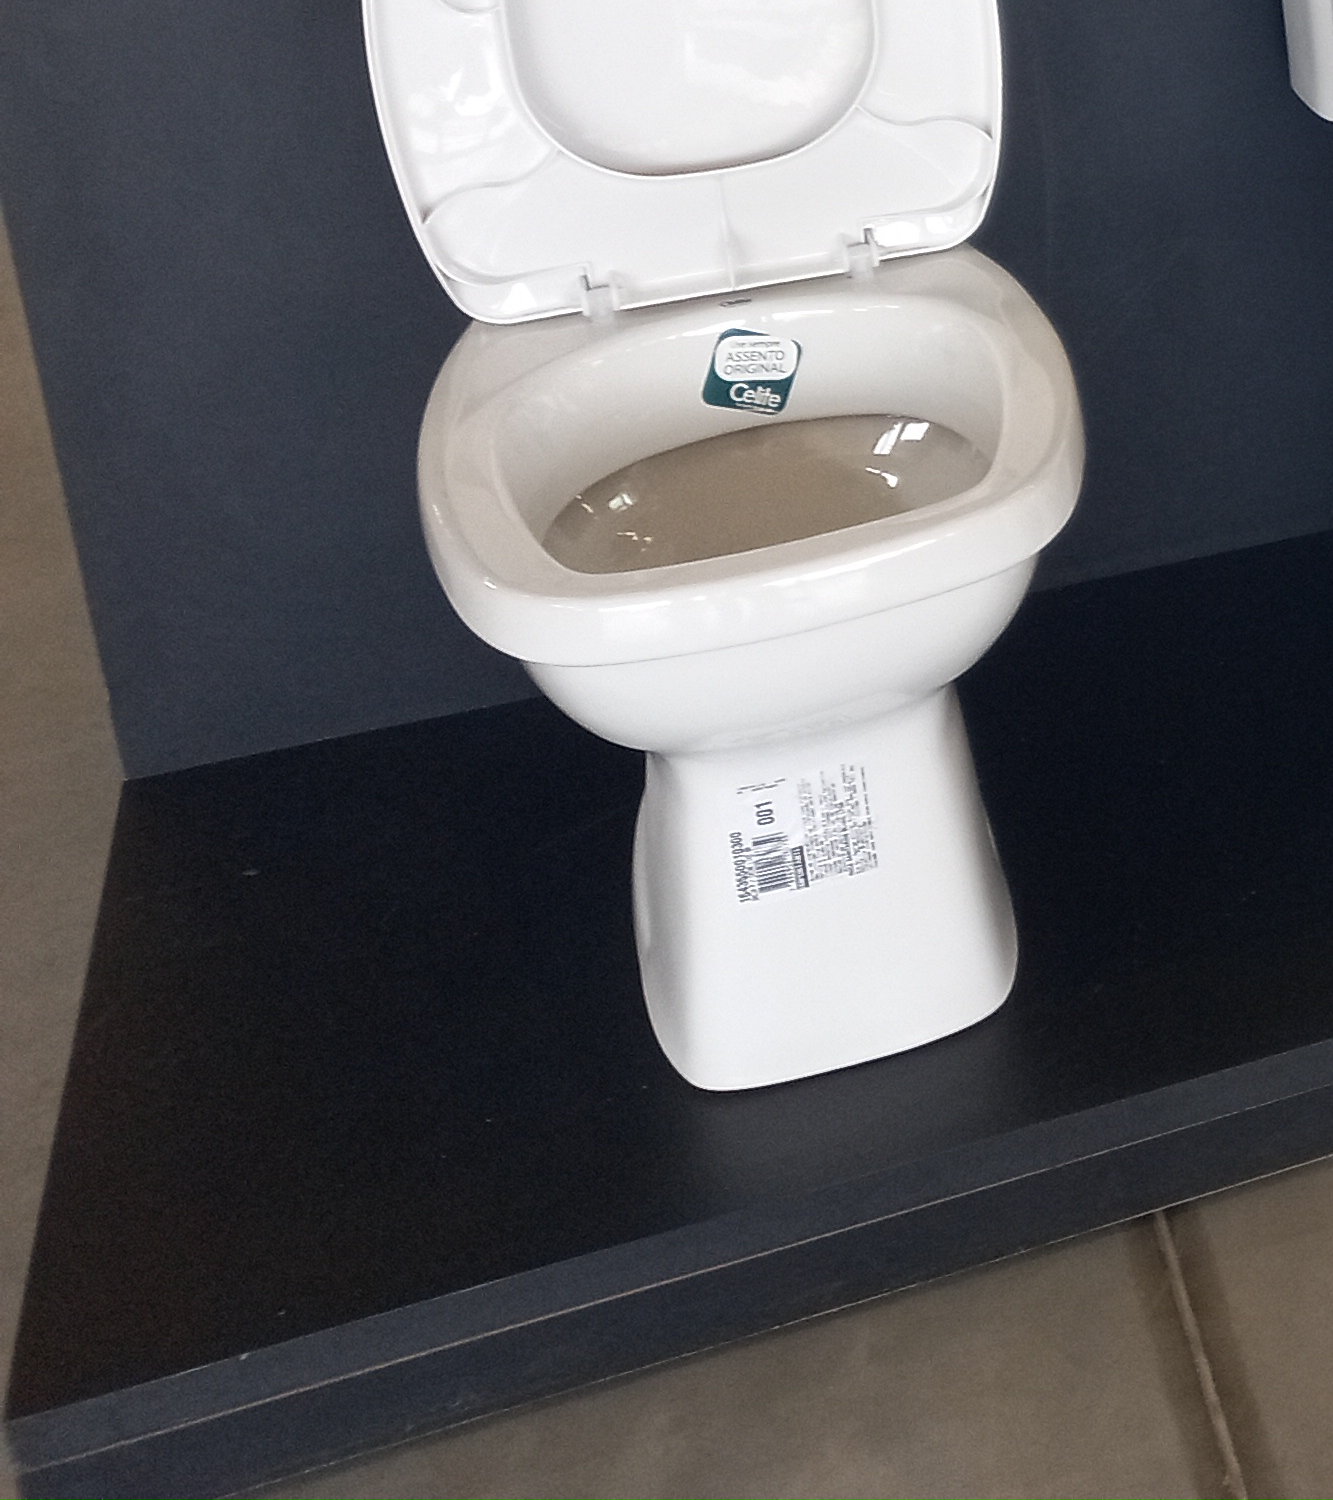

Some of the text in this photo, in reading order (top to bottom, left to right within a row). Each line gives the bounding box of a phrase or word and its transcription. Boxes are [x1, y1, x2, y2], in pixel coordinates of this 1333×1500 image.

[726, 350, 785, 362] ASSENTO
[723, 363, 787, 375] ORIGINAL
[754, 801, 776, 826] 001
